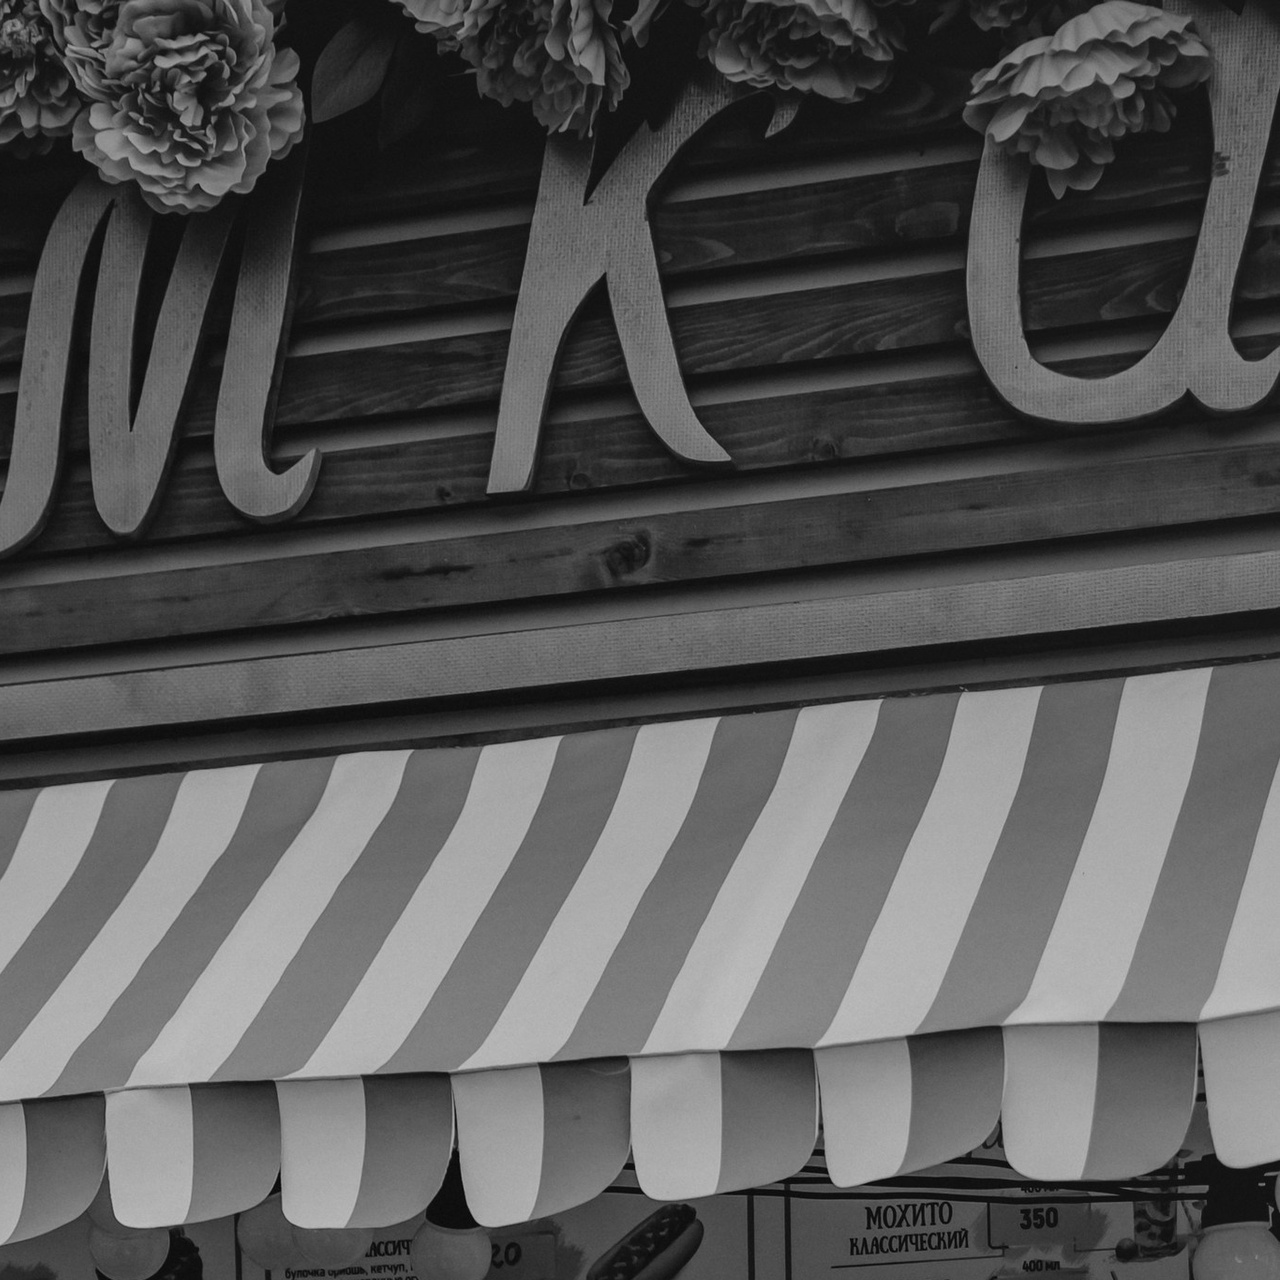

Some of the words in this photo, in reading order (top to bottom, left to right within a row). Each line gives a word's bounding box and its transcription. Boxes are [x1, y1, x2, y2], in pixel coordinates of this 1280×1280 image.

[865, 1202, 953, 1229] МОХИТО
[1020, 1207, 1059, 1229] 350
[849, 1228, 969, 1255] КЛАССИЧЕСКИЙ
[285, 1267, 325, 1280] булочка
[370, 1262, 408, 1276] кетчуп,
[1022, 1261, 1043, 1272] 400
[1045, 1262, 1060, 1272] мл
